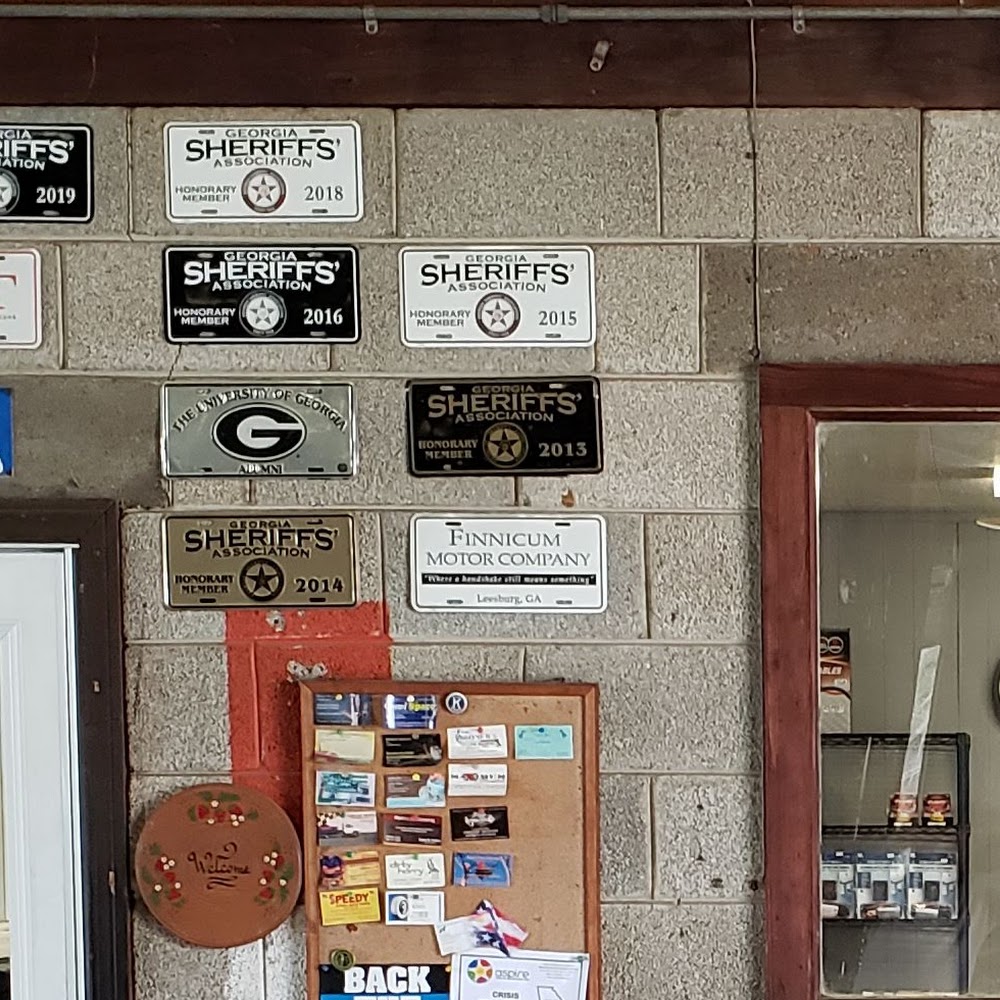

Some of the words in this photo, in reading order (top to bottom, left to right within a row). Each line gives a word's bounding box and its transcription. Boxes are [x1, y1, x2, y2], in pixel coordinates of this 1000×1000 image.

[225, 128, 298, 138] GEORGIA
[185, 138, 341, 162] SHERIFFS'
[213, 156, 312, 168] ASSOCIATION
[36, 186, 76, 204] 2019
[175, 185, 237, 194] HONORARY
[304, 184, 344, 201] 2018
[182, 193, 230, 202] MEMBER
[224, 251, 298, 262] GEORGIA
[465, 254, 527, 263] GEORGIA
[183, 261, 340, 286] SHERIFFS'
[420, 263, 575, 287] SHERIFFS'
[212, 279, 312, 292] ASSOCIATION
[447, 280, 547, 293] ASSOCIATION
[173, 308, 236, 317] HONORARY
[303, 308, 343, 326] 2016
[409, 309, 471, 319] HONORARY
[538, 310, 578, 326] 2015
[180, 316, 230, 326] MEMBER
[416, 318, 465, 327] MEMBER
[472, 384, 535, 393] GEORGIA
[172, 409, 196, 433] THE
[195, 387, 270, 413] UNIVERSITY
[273, 389, 292, 401] OF
[295, 393, 348, 433] GEORGIA
[427, 392, 582, 418] SHERIFFS'
[455, 411, 554, 424] ASSOCIATION
[418, 439, 478, 450] HONORARY
[538, 442, 587, 458] 2013
[425, 449, 473, 460] MEMBER
[239, 464, 283, 475] ALUMNI
[229, 520, 291, 529] GEORGIA
[184, 528, 339, 553] SHERIFFS'
[449, 528, 561, 548] FINNICUM
[212, 547, 311, 558] ASSOCIATION
[426, 551, 494, 566] MOTOR
[498, 552, 591, 567] COMPANY
[175, 574, 234, 584] HONORARY
[461, 574, 502, 583] handshake
[504, 575, 521, 583] still
[523, 576, 548, 584] means
[181, 584, 229, 594] MEMBER
[295, 577, 344, 594] 2014
[525, 594, 542, 604] GA
[329, 893, 369, 905] SPEEDY
[344, 965, 431, 993] BACK
[495, 968, 530, 979] aspire
[492, 991, 520, 999] CRISIS
